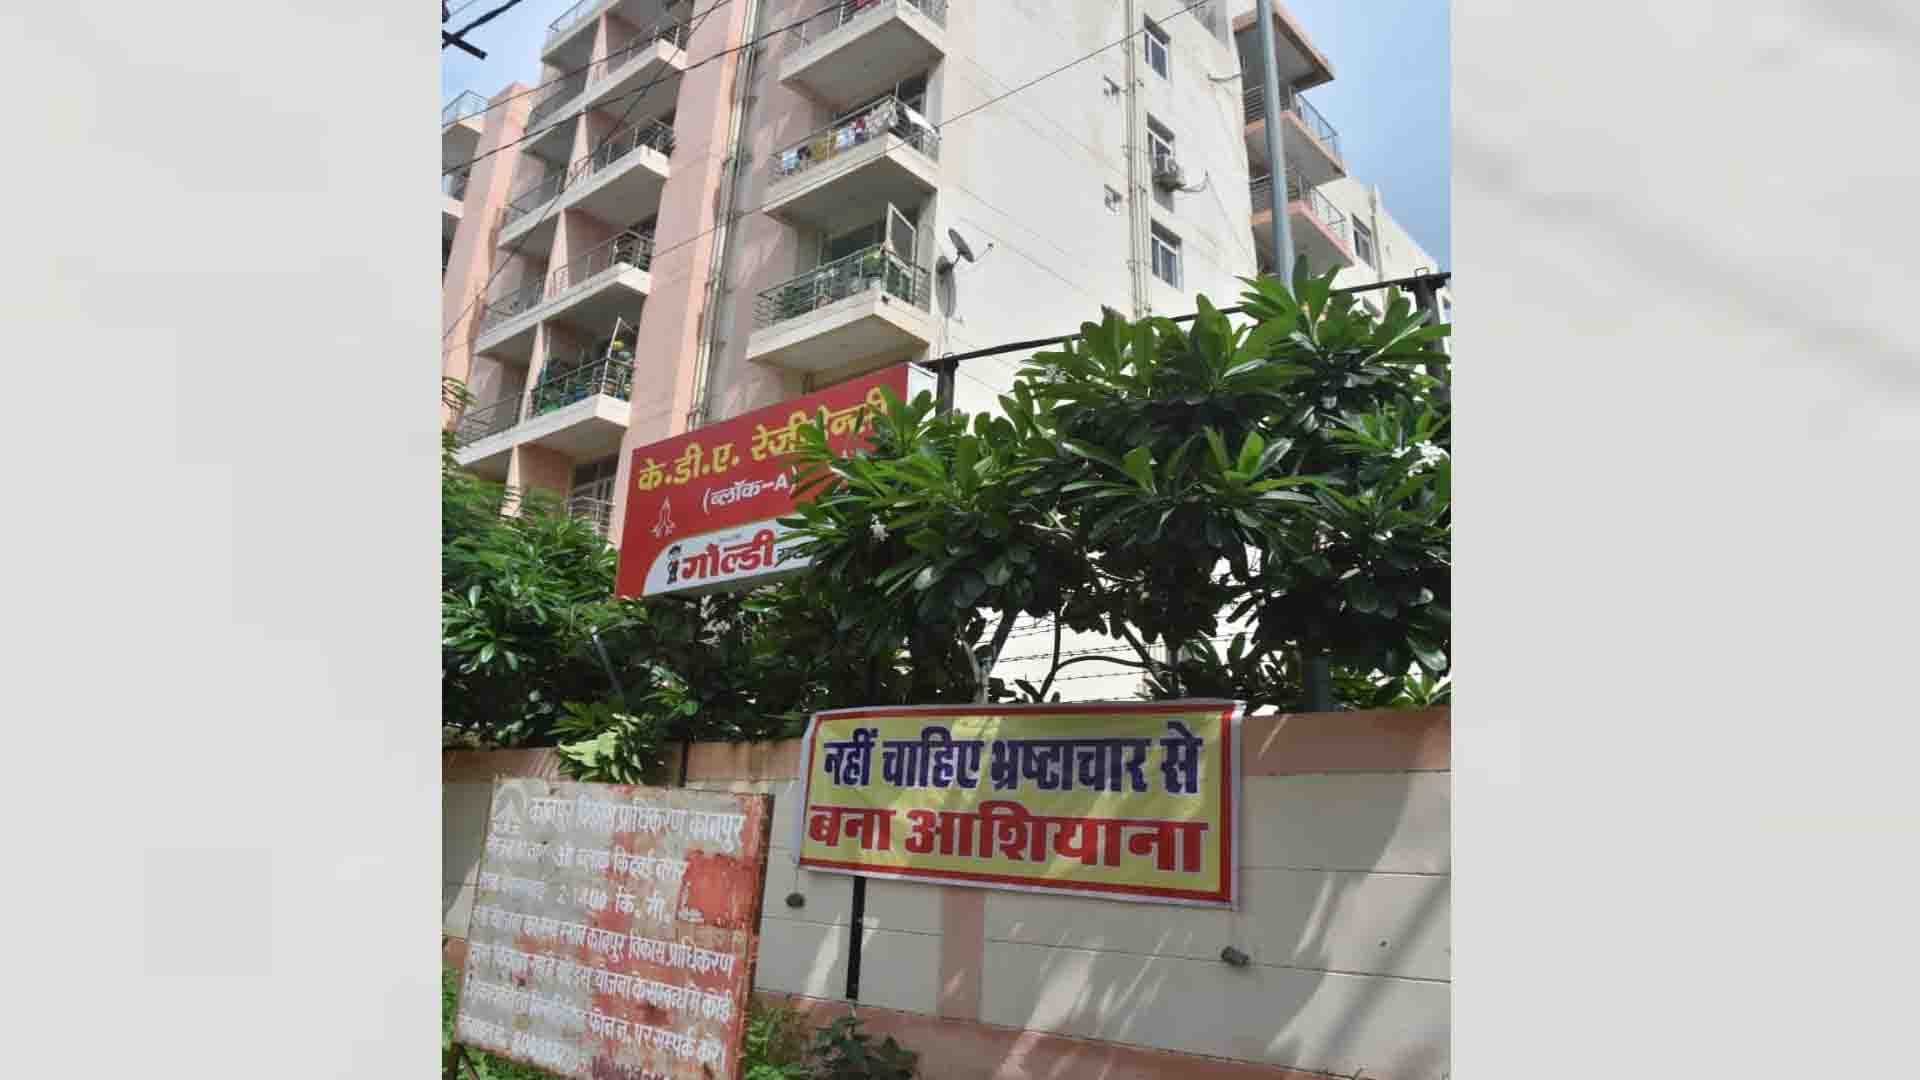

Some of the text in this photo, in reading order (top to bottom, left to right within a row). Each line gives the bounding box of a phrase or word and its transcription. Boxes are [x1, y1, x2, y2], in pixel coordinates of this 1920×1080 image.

[638, 442, 740, 491] के.डी.ए.
[824, 720, 1203, 793] नहीं चाहिए भ्रष्टाचार से
[808, 800, 1208, 872] बना आशियाना
